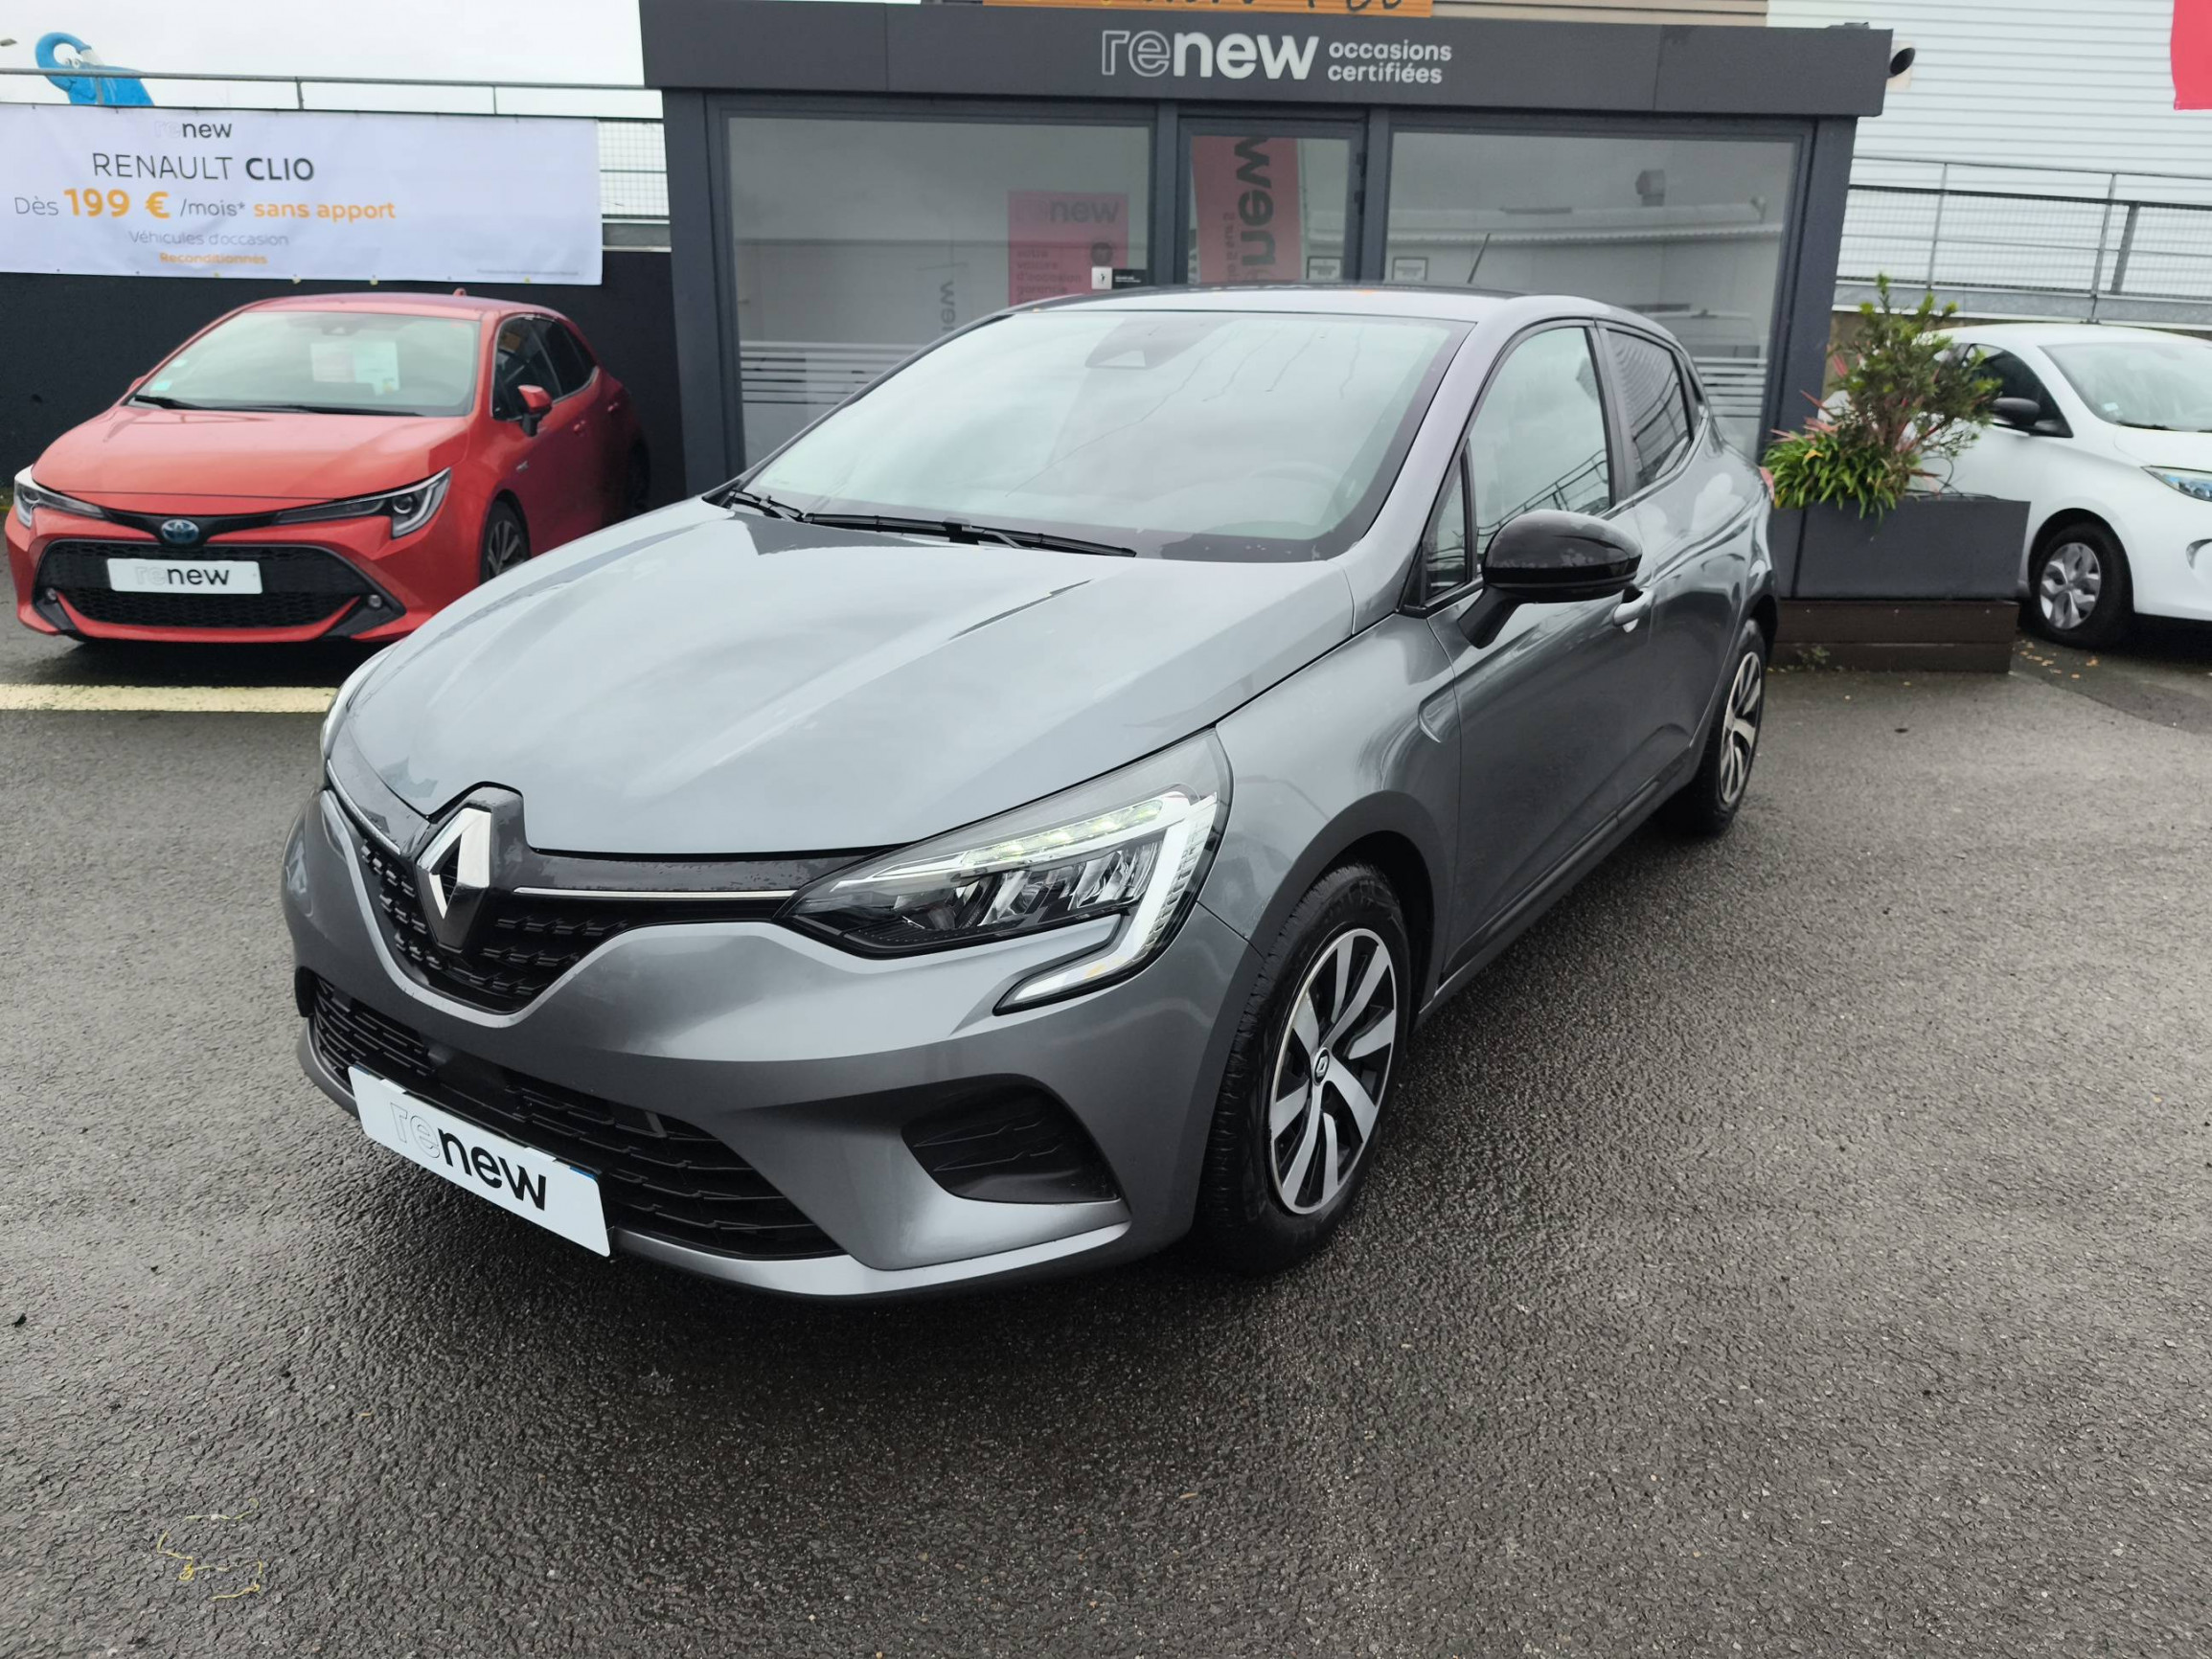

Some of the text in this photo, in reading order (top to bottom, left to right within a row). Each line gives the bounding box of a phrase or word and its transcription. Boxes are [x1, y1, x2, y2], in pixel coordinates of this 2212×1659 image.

[1102, 30, 1319, 80] renew
[1329, 39, 1452, 62] occasions
[1328, 61, 1443, 84] certifiées
[92, 152, 315, 181] RENAULT CLIO
[14, 195, 59, 216] Dès
[63, 188, 130, 217] 199
[145, 191, 171, 219] €
[253, 201, 310, 219] sans
[316, 201, 396, 223] apport
[128, 231, 289, 246] Véhicules d'occasion
[159, 251, 269, 265] Reconditionnés
[134, 566, 230, 586] renew
[390, 1102, 547, 1212] renew
